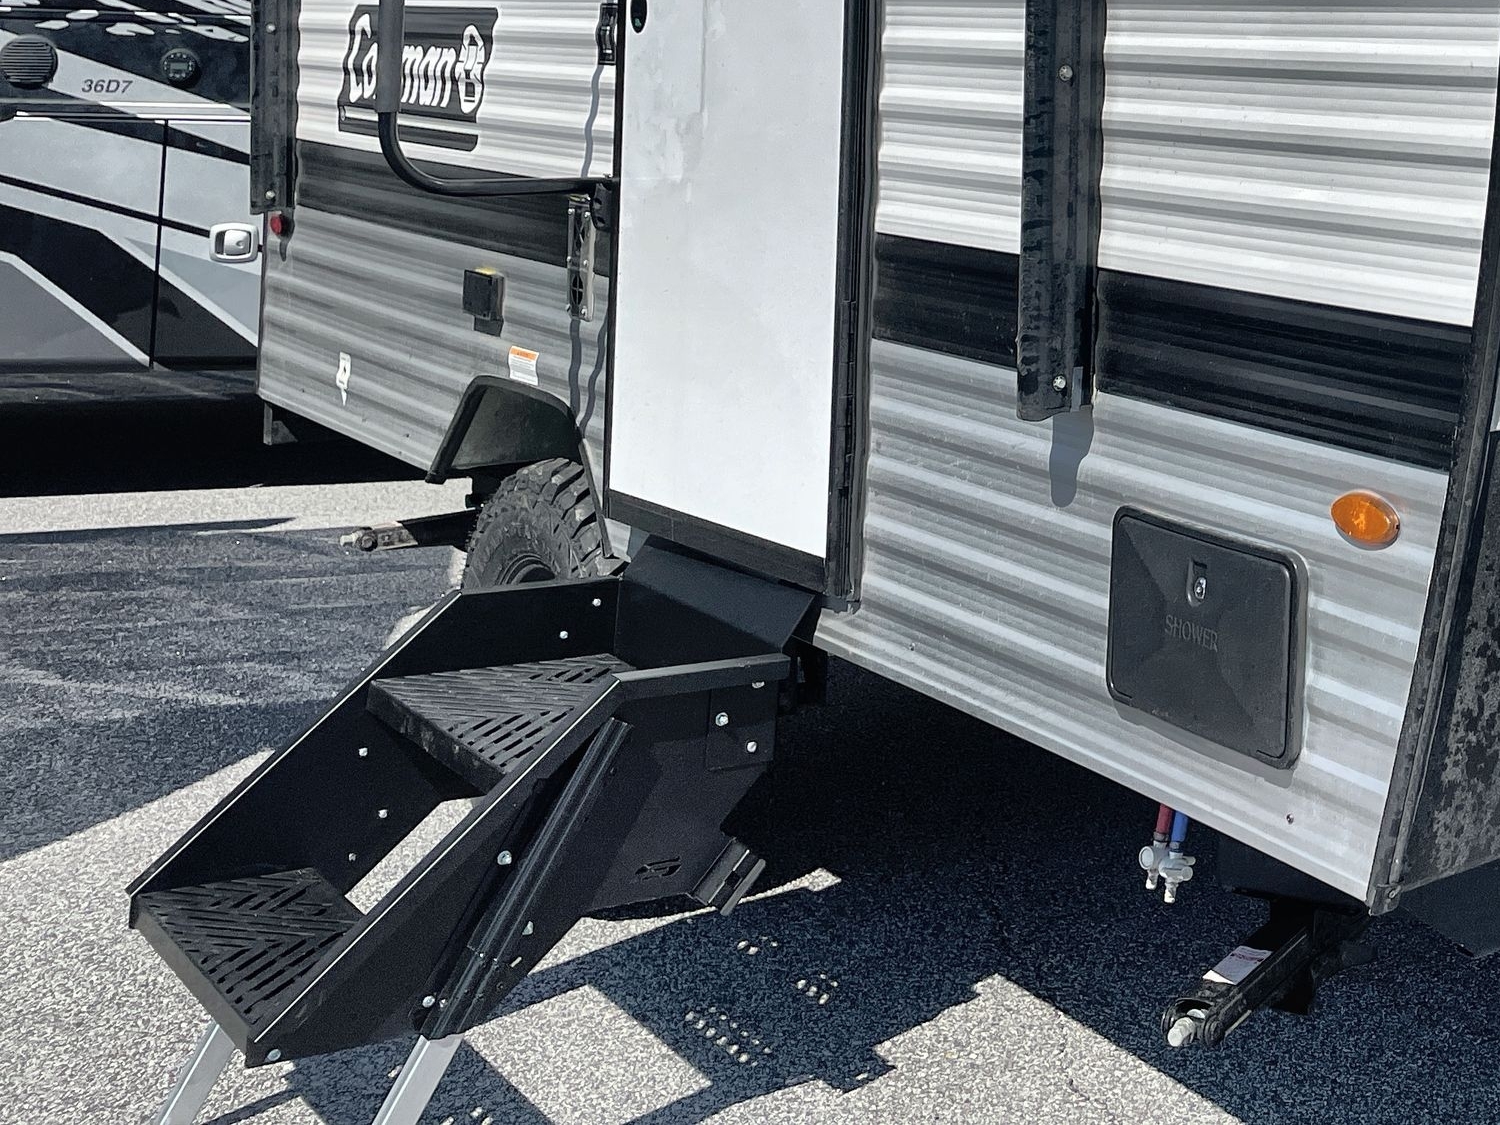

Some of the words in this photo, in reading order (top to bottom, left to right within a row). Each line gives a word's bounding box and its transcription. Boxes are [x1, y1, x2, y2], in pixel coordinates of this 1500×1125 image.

[347, 13, 457, 108] Coman
[81, 78, 134, 94] 36D7
[1164, 614, 1218, 653] SHOWER
